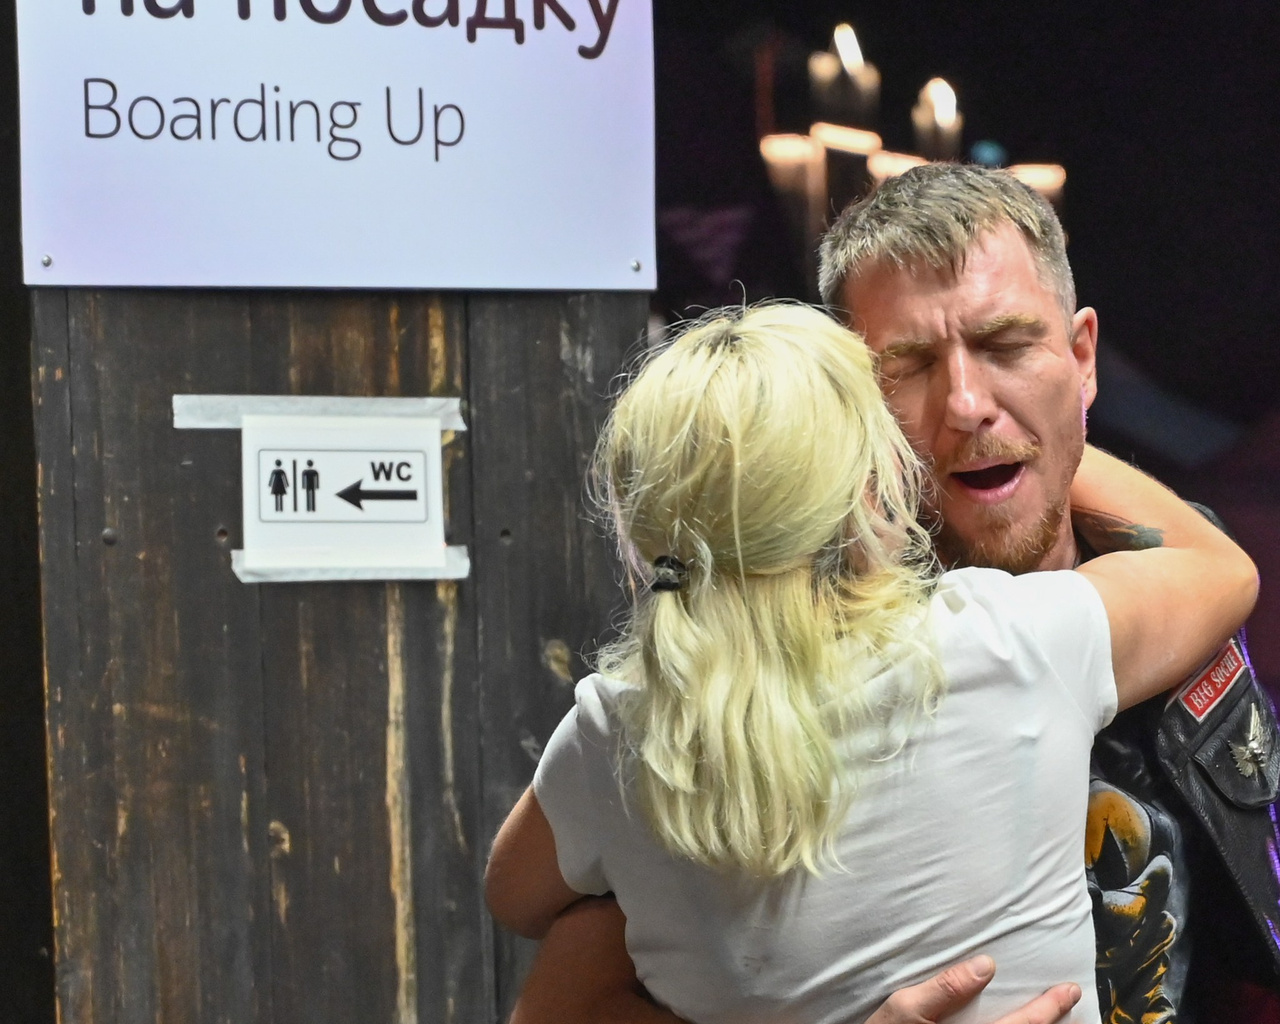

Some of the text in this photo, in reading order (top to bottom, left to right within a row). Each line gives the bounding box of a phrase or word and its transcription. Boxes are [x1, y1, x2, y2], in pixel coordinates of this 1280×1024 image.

[83, 77, 466, 162] Boarding Up
[370, 461, 413, 482] WC
[1188, 680, 1214, 711] BIG
